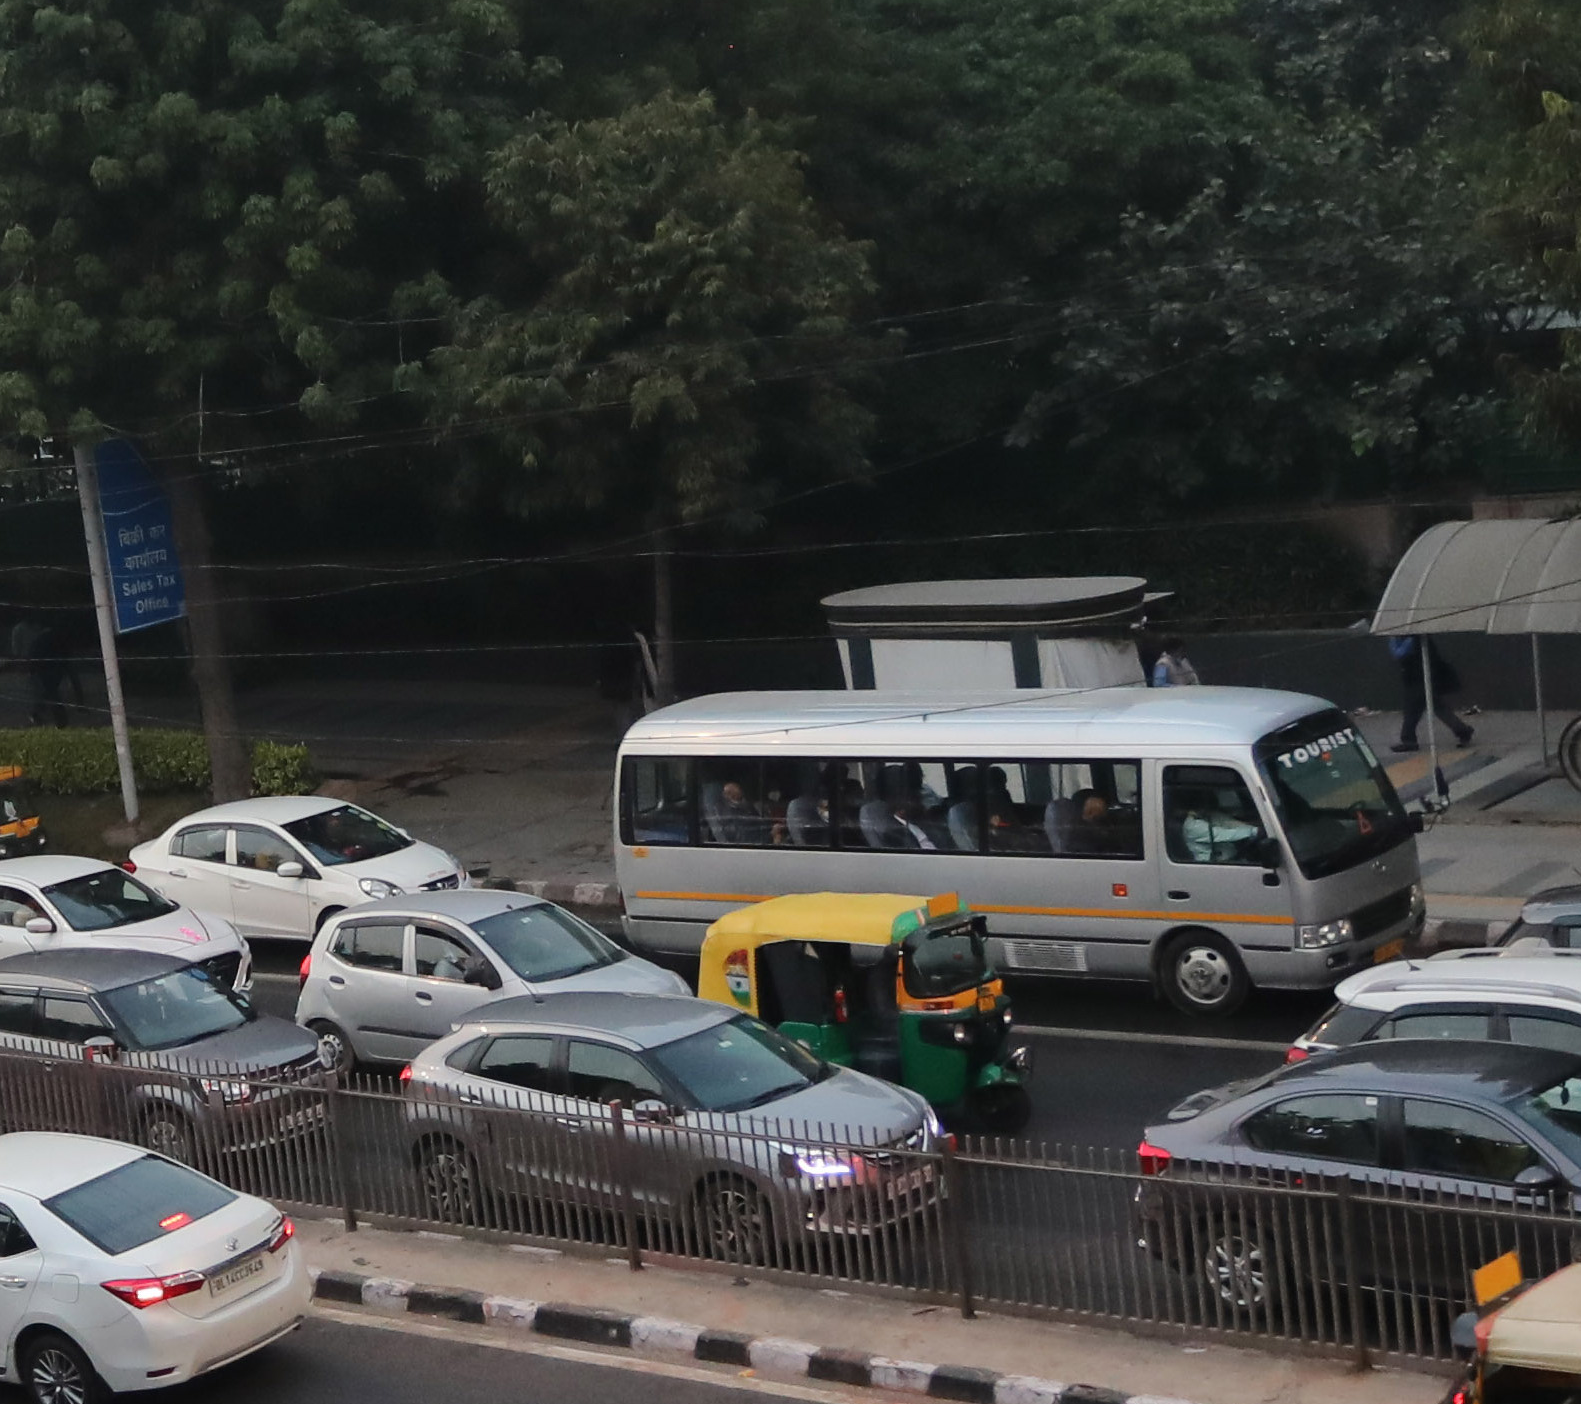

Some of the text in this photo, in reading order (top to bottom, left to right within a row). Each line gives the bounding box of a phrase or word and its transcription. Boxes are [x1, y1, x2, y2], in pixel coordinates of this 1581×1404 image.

[123, 548, 167, 570] कार्यालय
[122, 574, 176, 596] Sales Tax
[135, 597, 169, 614] Office
[1277, 728, 1355, 769] TOURIST
